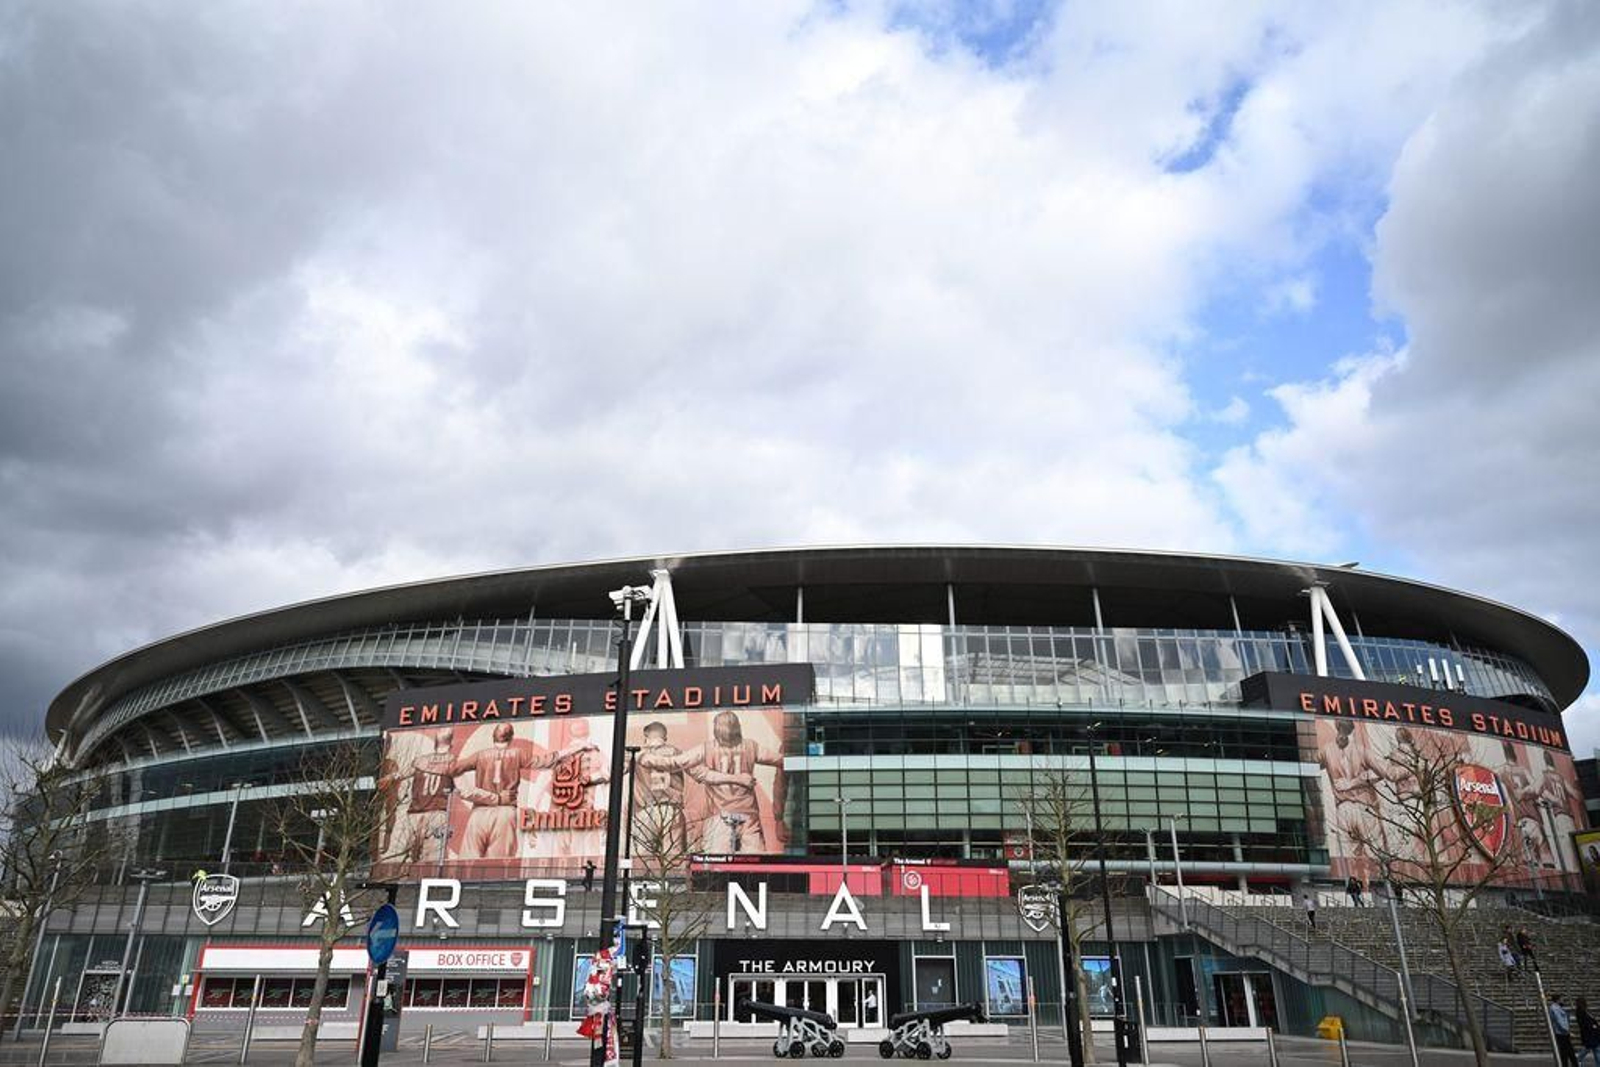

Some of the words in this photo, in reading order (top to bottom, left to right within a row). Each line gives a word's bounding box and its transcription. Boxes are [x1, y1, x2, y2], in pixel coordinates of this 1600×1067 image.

[399, 694, 572, 726] EMIRATES
[604, 683, 782, 711] STADIUM
[1300, 693, 1453, 727] EMIRATES
[1471, 712, 1564, 748] STADIUM
[1459, 777, 1500, 796] Arsenal
[521, 806, 607, 831] Emirate
[199, 881, 234, 893] Arsenal
[437, 953, 463, 966] BOX
[466, 953, 506, 966] OFFICE
[739, 959, 776, 973] THE
[782, 959, 876, 973] ARMOURY
